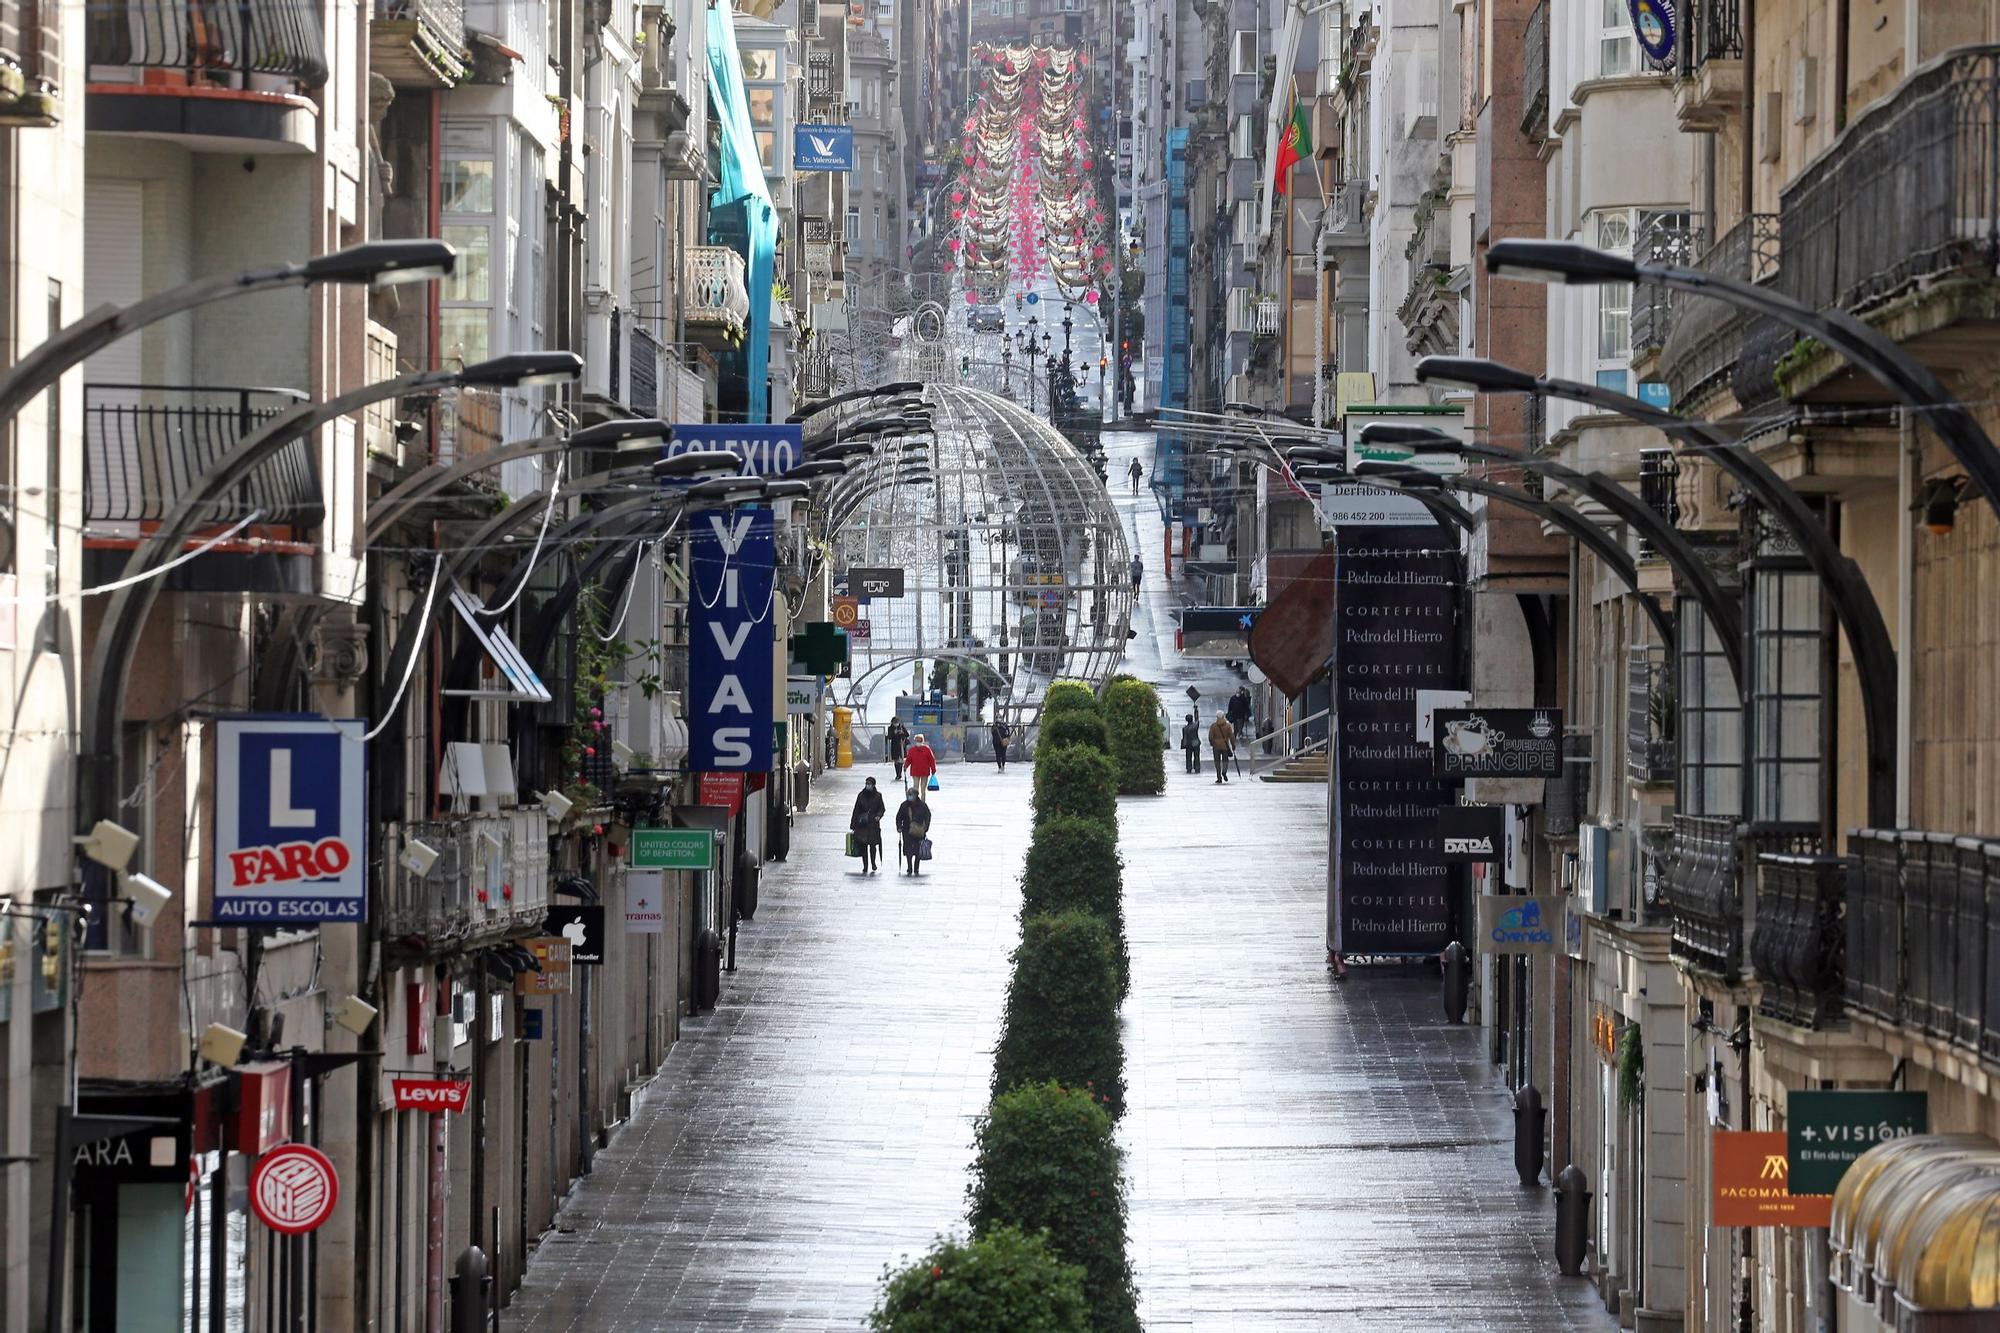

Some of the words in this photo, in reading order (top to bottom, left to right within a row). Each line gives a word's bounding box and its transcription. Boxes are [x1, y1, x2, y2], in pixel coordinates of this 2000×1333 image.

[1332, 511, 1349, 521] 986
[1350, 511, 1367, 521] 452
[1368, 511, 1385, 521] 200
[1346, 547, 1444, 559] CORTEFIEL
[1347, 570, 1382, 584] Pedro
[1383, 570, 1400, 584] del
[1404, 570, 1444, 584] Hierro
[1346, 606, 1444, 616] CORTEFIEL
[707, 515, 756, 767] VIVAS
[1346, 629, 1381, 642] Pedro
[1382, 629, 1400, 642] del
[1403, 629, 1443, 642] Hierro
[1347, 664, 1444, 674] CORTEFIEL
[1348, 687, 1383, 700] Pedro
[1384, 687, 1401, 700] del
[1346, 722, 1413, 732] CORTEF
[1348, 745, 1382, 759] Pedro
[1383, 745, 1400, 759] del
[1503, 739, 1557, 752] PUERTA
[269, 748, 317, 828] L
[1348, 781, 1443, 791] CORTEFIEL
[1350, 804, 1383, 817] Pedro
[1384, 804, 1401, 817] del
[640, 840, 671, 849] UNITED
[671, 840, 705, 849] COLORS
[1351, 839, 1436, 849] CORTEFIE
[1444, 836, 1493, 853] DADÁ
[229, 839, 350, 887] FARO
[1352, 862, 1387, 875] Pedro
[1388, 862, 1405, 875] del
[1407, 862, 1448, 875] Hierro
[1351, 896, 1447, 906] CORTEFIEL
[219, 900, 273, 916] AUTO
[277, 900, 359, 916] ESCOLAS
[1352, 918, 1386, 932] Pedro
[1387, 918, 1404, 932] del
[1407, 918, 1447, 932] Hierro
[576, 953, 599, 961] Reseller
[1800, 1149, 1811, 1160] El
[1812, 1149, 1826, 1160] fin
[1827, 1149, 1841, 1160] de
